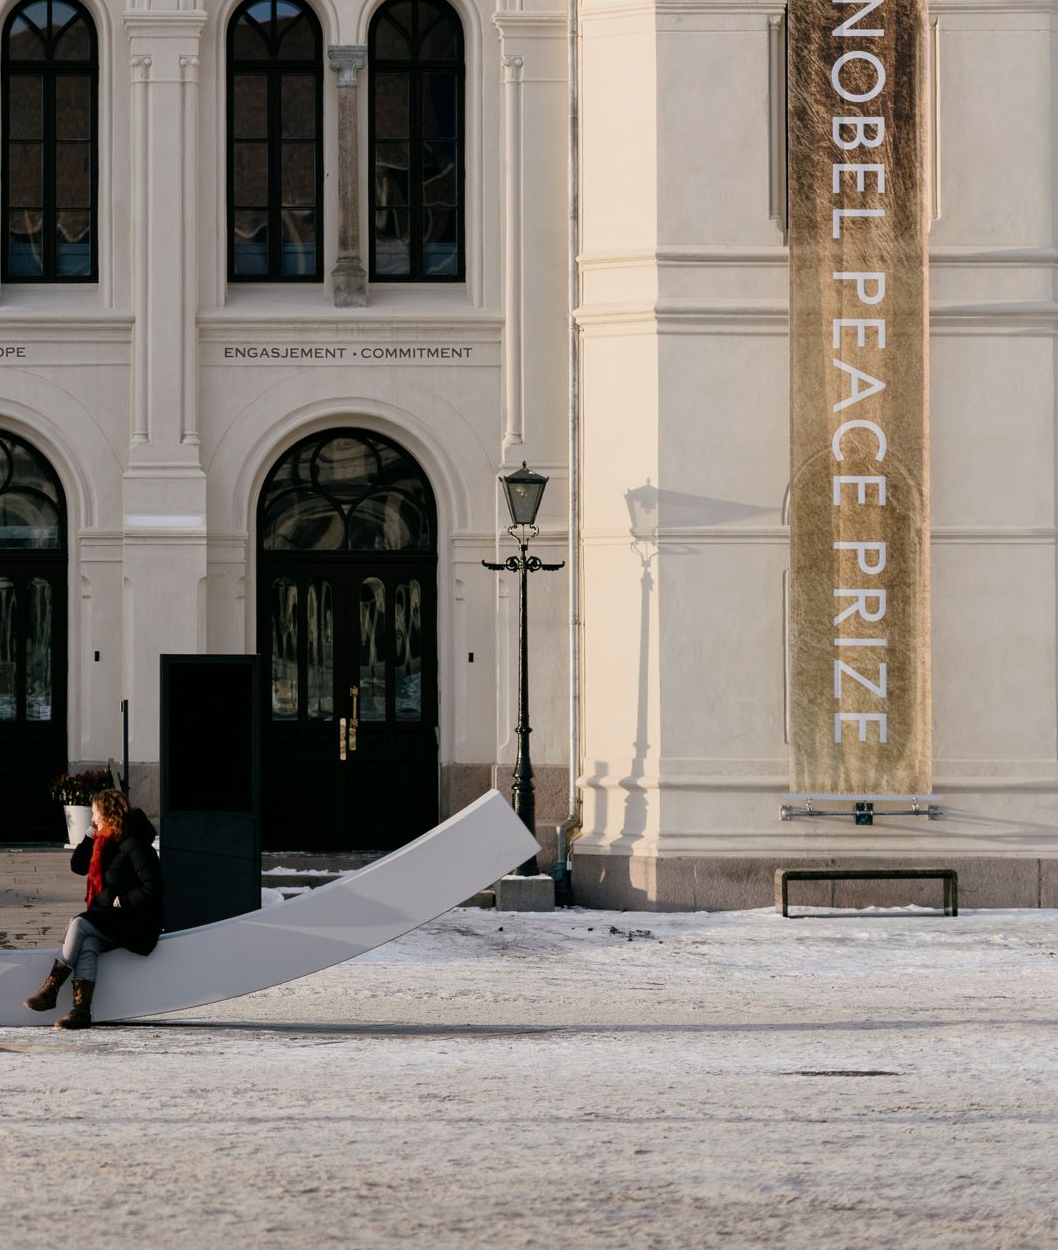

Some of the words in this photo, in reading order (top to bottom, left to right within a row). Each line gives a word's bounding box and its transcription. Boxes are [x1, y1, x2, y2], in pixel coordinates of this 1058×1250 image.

[224, 347, 346, 359] ENGASJEMENT
[360, 347, 473, 359] COMMITMENT
[832, 271, 887, 506] PEACE
[833, 541, 888, 743] PRIZE
